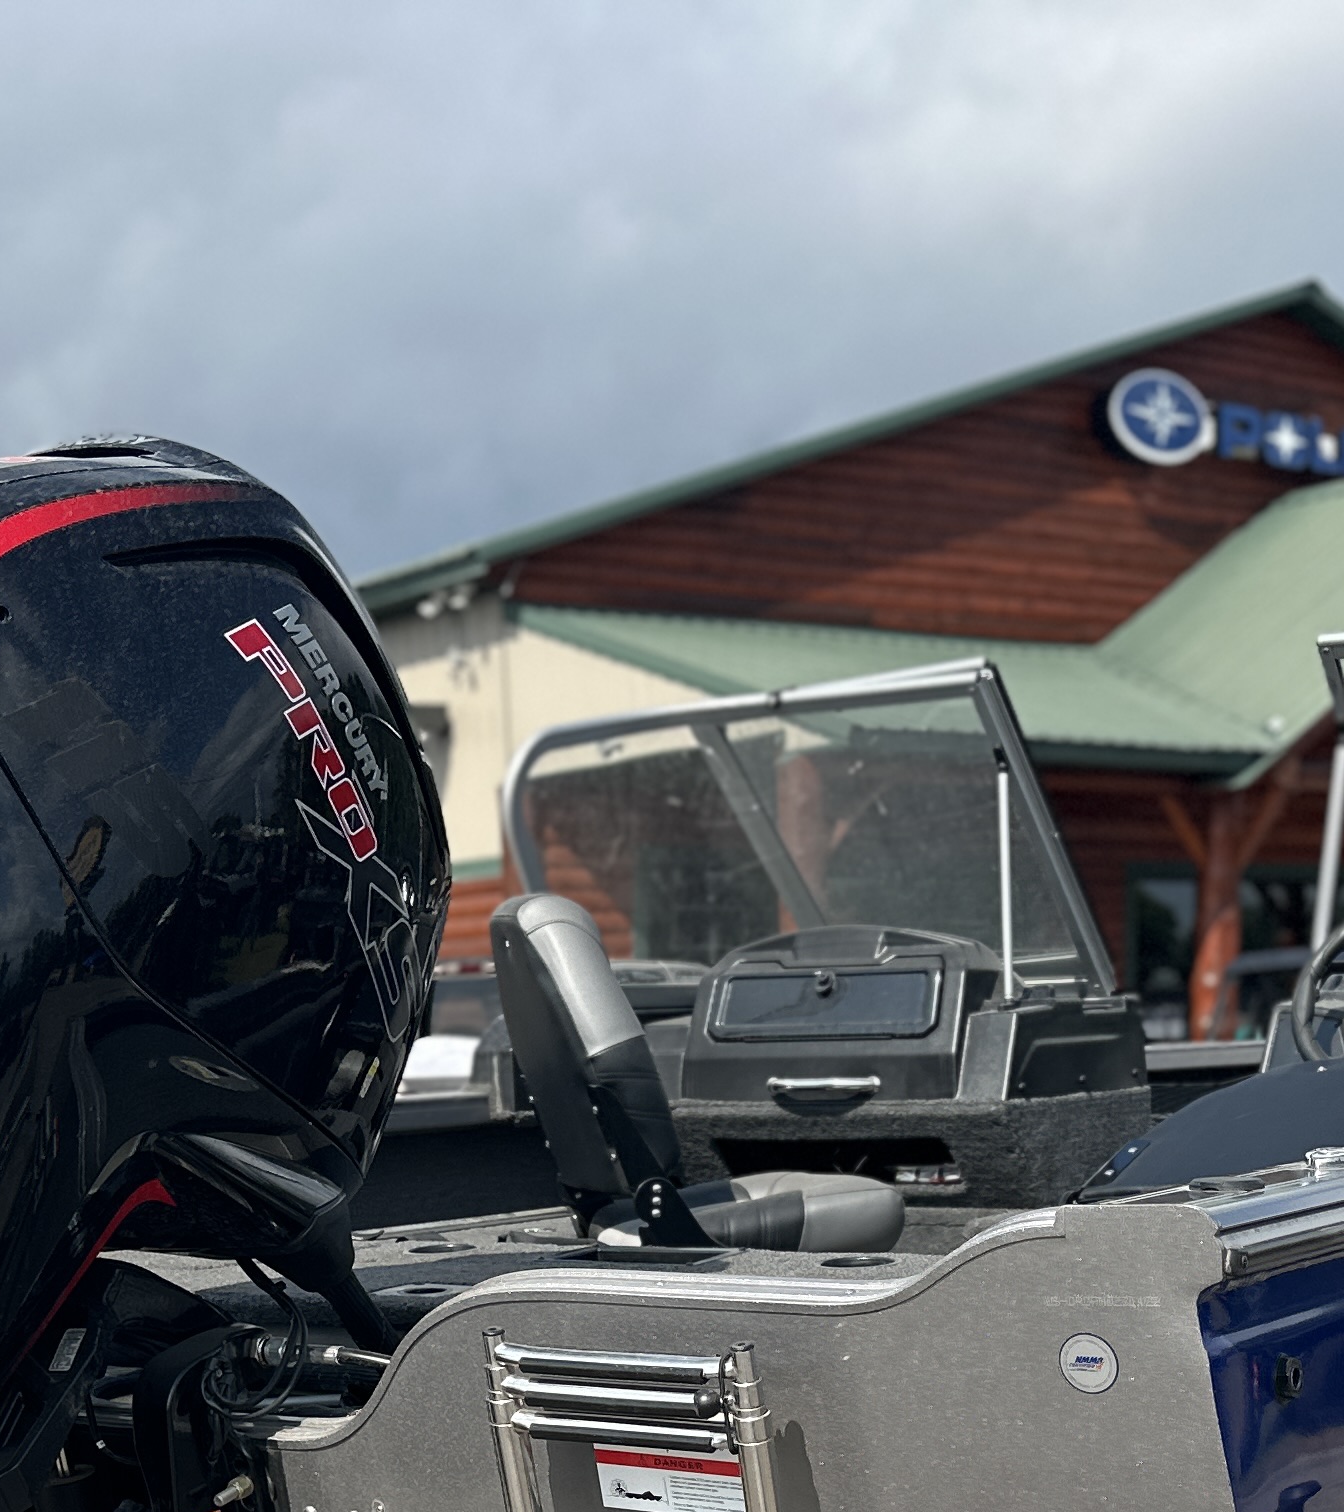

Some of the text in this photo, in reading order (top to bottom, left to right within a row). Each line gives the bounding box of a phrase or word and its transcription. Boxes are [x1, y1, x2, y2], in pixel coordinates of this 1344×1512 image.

[224, 618, 377, 863] PRO
[273, 603, 388, 800] MERCURY
[654, 1457, 704, 1471] DANGER
